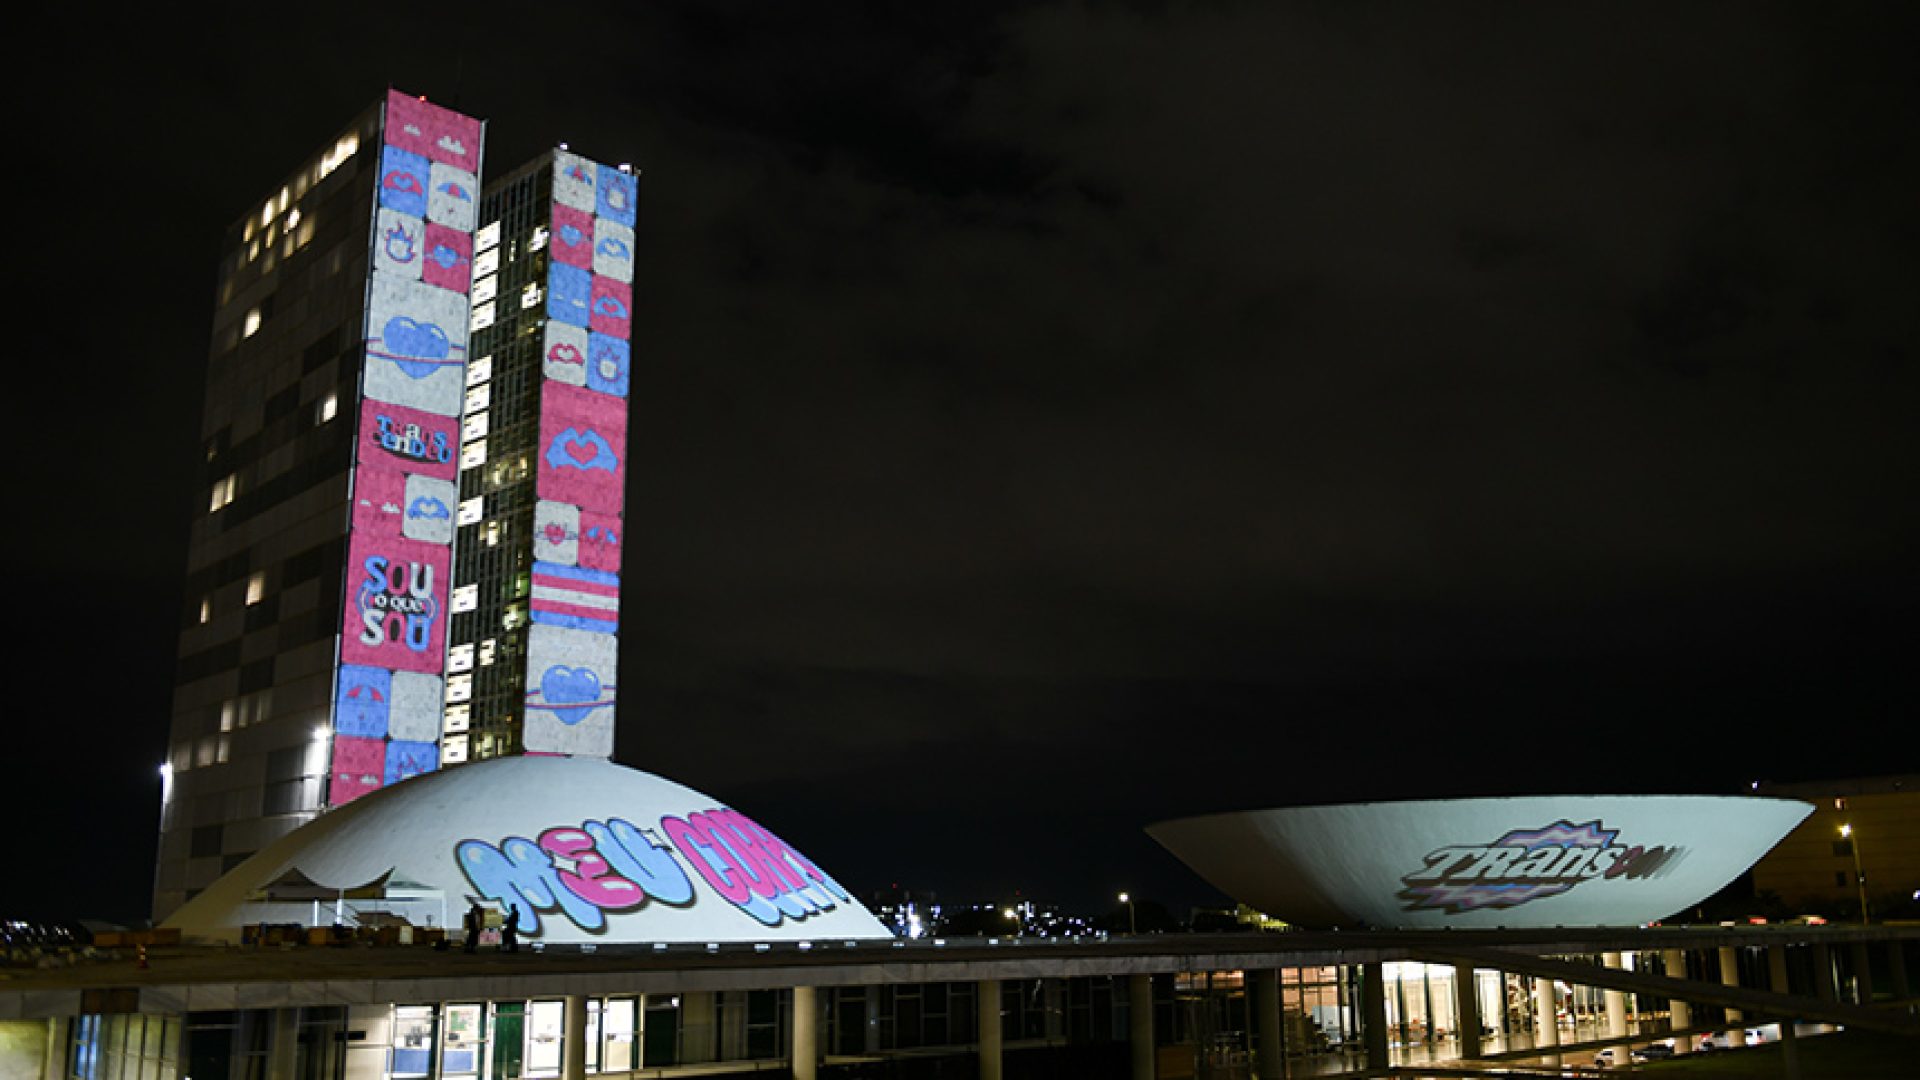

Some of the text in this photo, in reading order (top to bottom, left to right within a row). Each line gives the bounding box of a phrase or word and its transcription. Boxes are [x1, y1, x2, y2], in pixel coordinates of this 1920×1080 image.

[363, 556, 433, 598] SOU
[360, 609, 430, 651] SOU
[455, 807, 848, 935] MEU CORP
